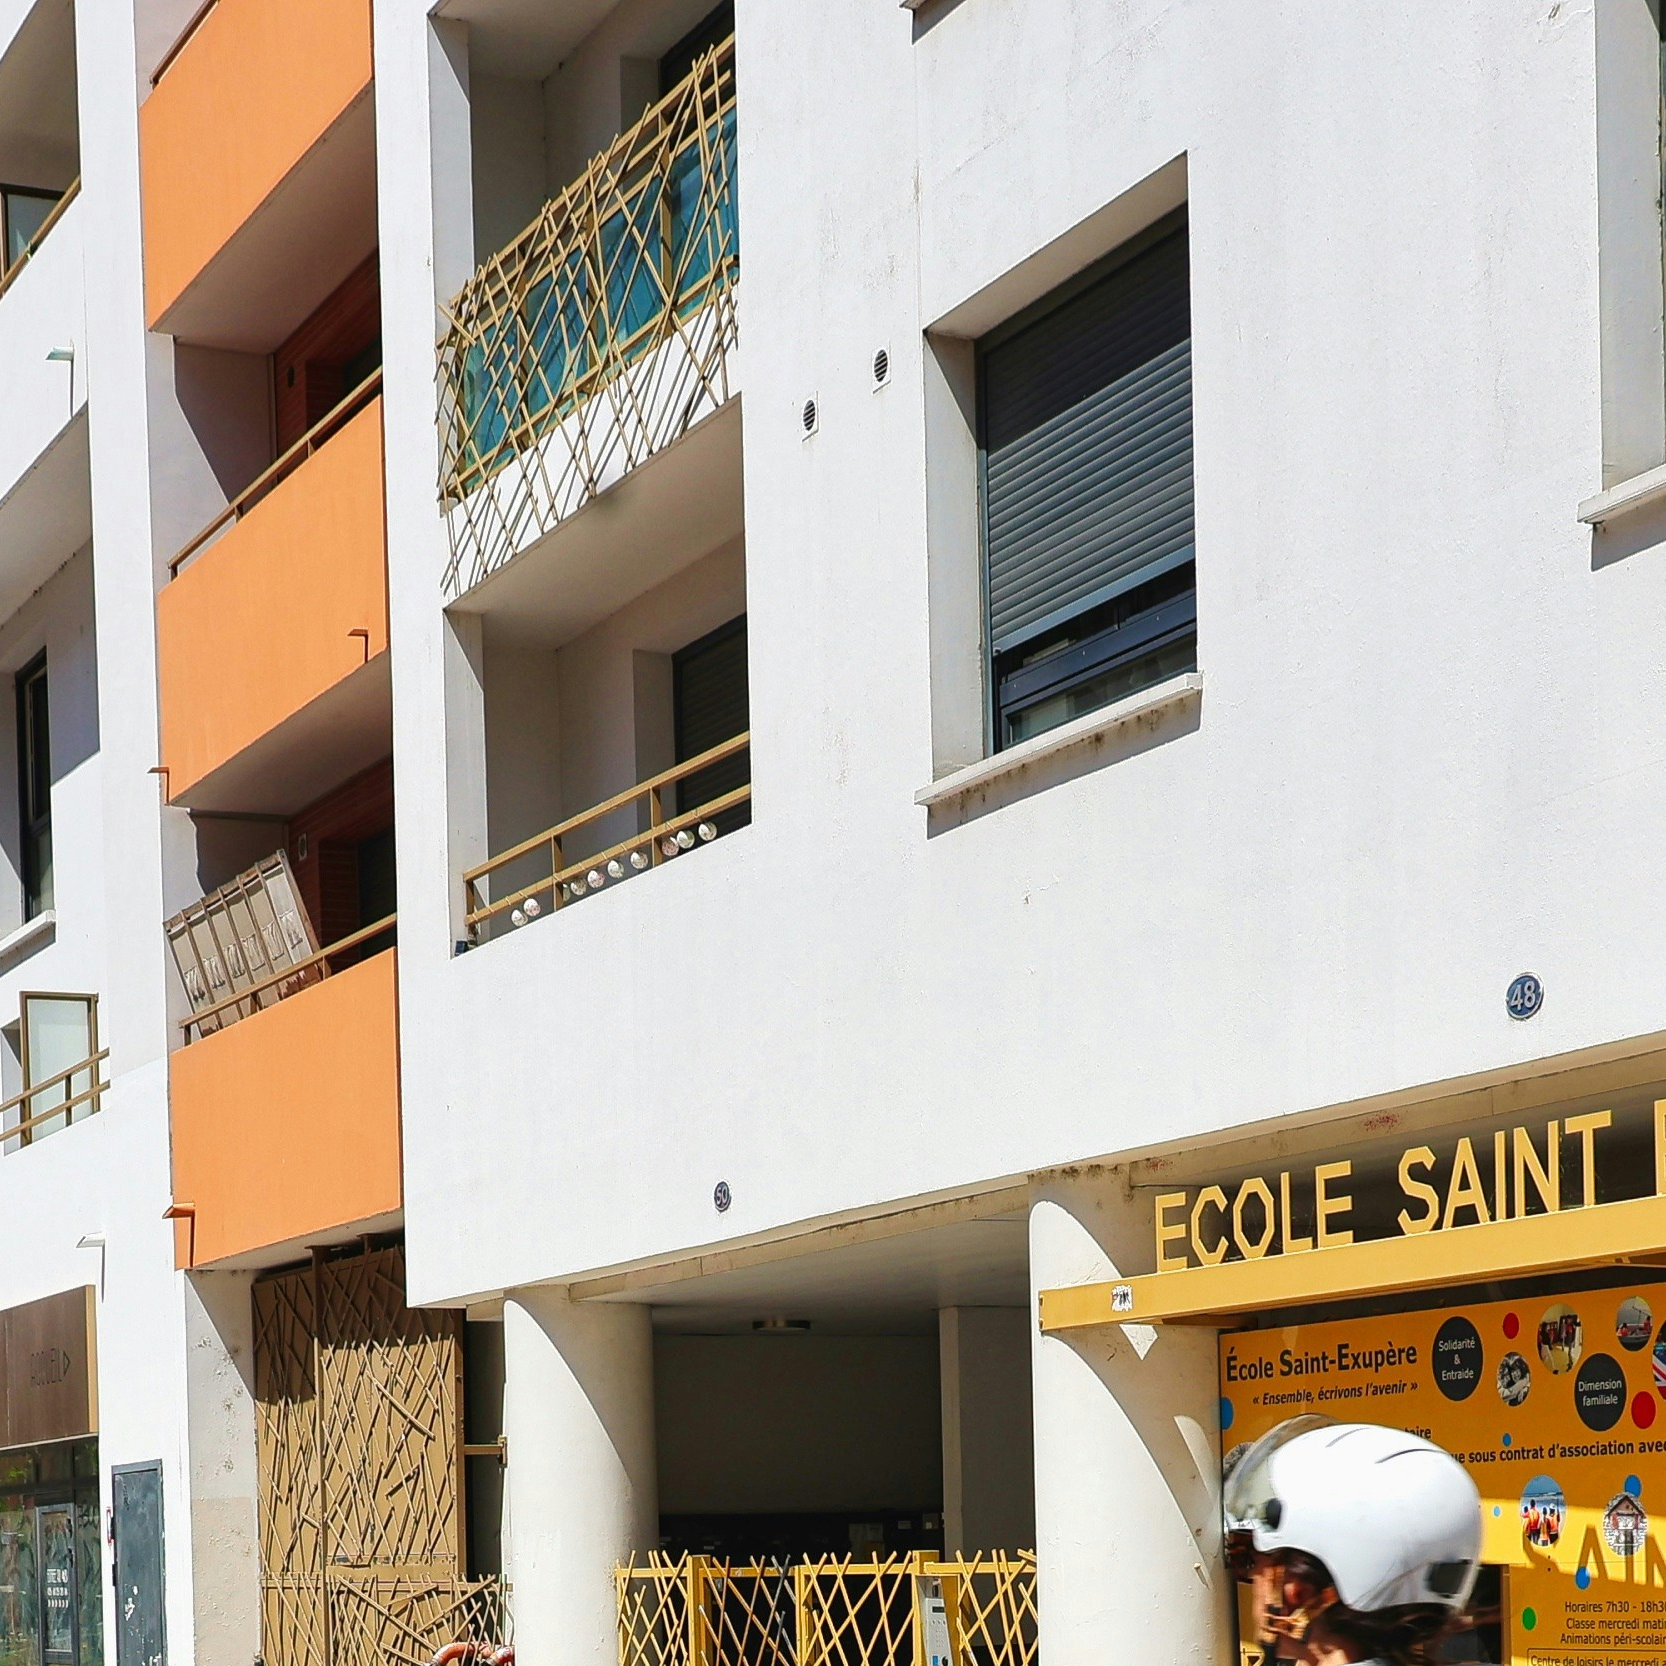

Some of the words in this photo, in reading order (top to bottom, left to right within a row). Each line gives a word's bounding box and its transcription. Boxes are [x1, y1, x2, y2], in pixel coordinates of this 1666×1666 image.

[1510, 980, 1536, 1011] 48
[1153, 1159, 1354, 1273] ECOLE
[1397, 1109, 1612, 1234] SAINT
[1438, 1337, 1476, 1352] Solidarité
[1226, 1346, 1274, 1382] École
[1279, 1341, 1417, 1377] Saint-Exupère
[1453, 1353, 1461, 1365] &
[1441, 1368, 1475, 1381] Entraide
[1578, 1379, 1623, 1392] Dimension
[1262, 1388, 1315, 1406] Ensemble,
[1318, 1385, 1363, 1401] écrivons
[1365, 1381, 1407, 1397] l'avenir
[1582, 1393, 1619, 1407] familiale
[1468, 1449, 1497, 1464] sous
[1499, 1444, 1545, 1462] contrat
[1547, 1440, 1634, 1459] d'association
[1564, 1601, 1603, 1613] Horaires
[1606, 1601, 1630, 1613] 7h30
[1566, 1617, 1595, 1629] Classe
[1598, 1618, 1640, 1630] mercredi
[1560, 1632, 1611, 1645] Animations
